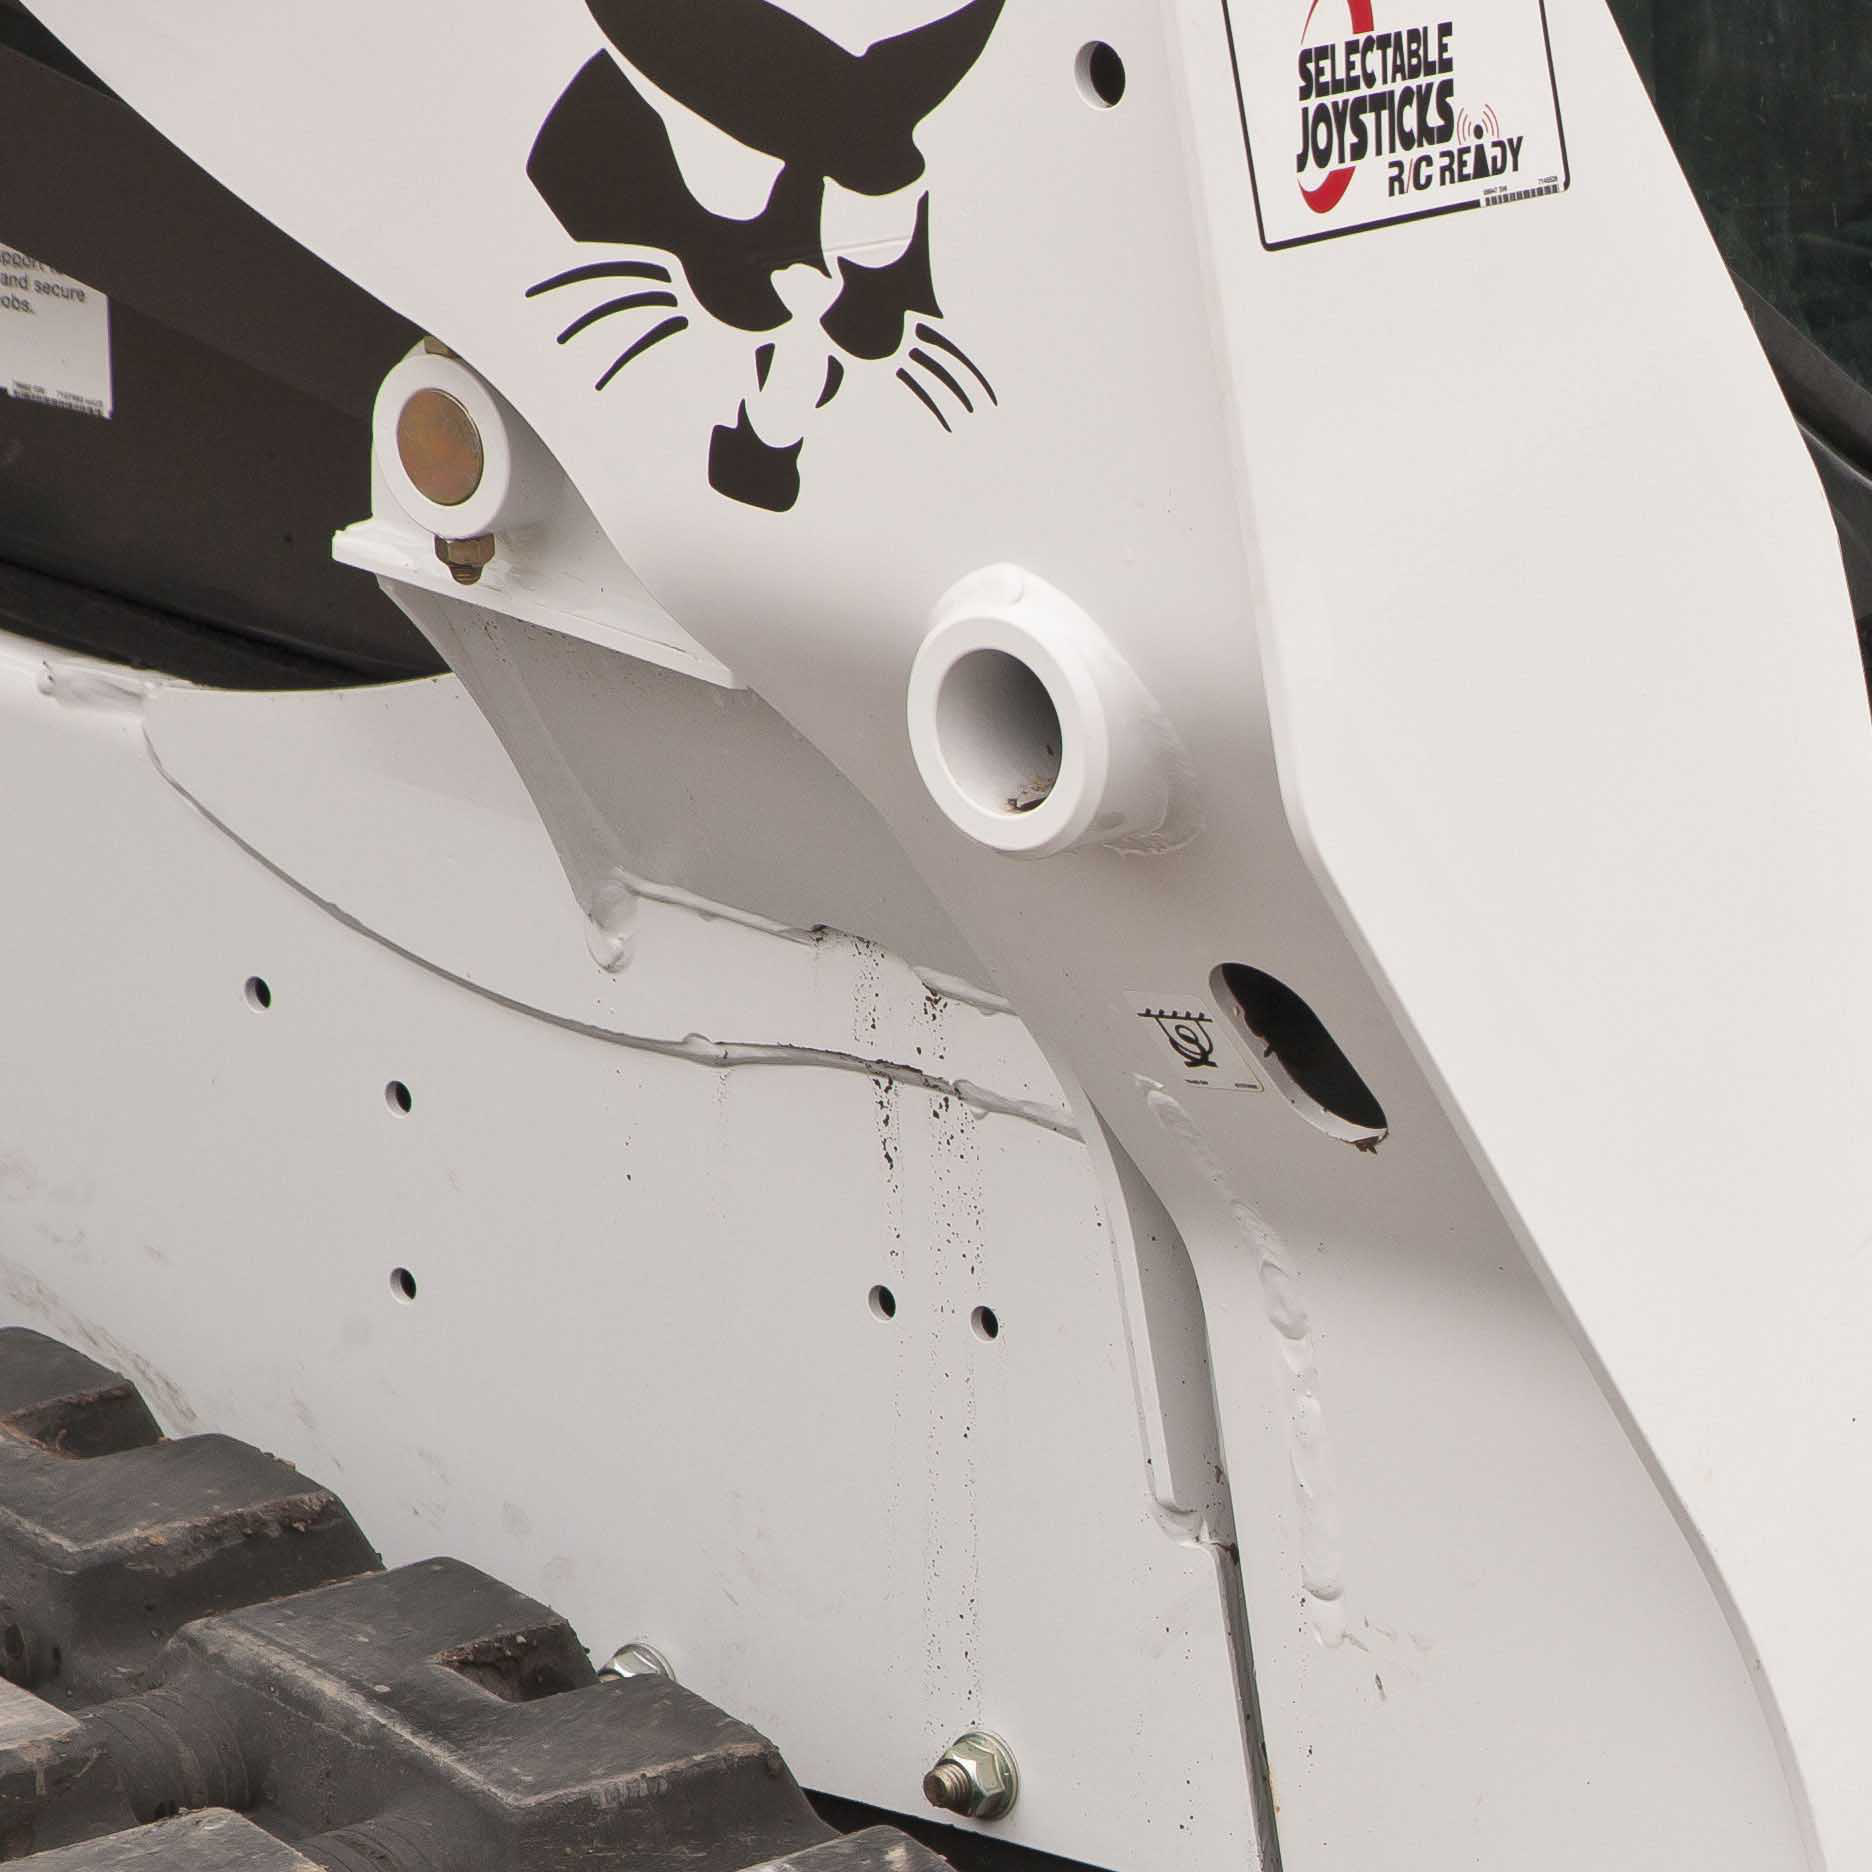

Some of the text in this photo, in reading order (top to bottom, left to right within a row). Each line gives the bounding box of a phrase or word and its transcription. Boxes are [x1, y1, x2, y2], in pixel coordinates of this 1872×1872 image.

[1298, 21, 1453, 101] SELECTABLE
[1296, 78, 1455, 173] JOYSTICKS
[1388, 154, 1434, 197] R/C
[1439, 136, 1524, 187] READY
[0, 271, 86, 303] and secure
